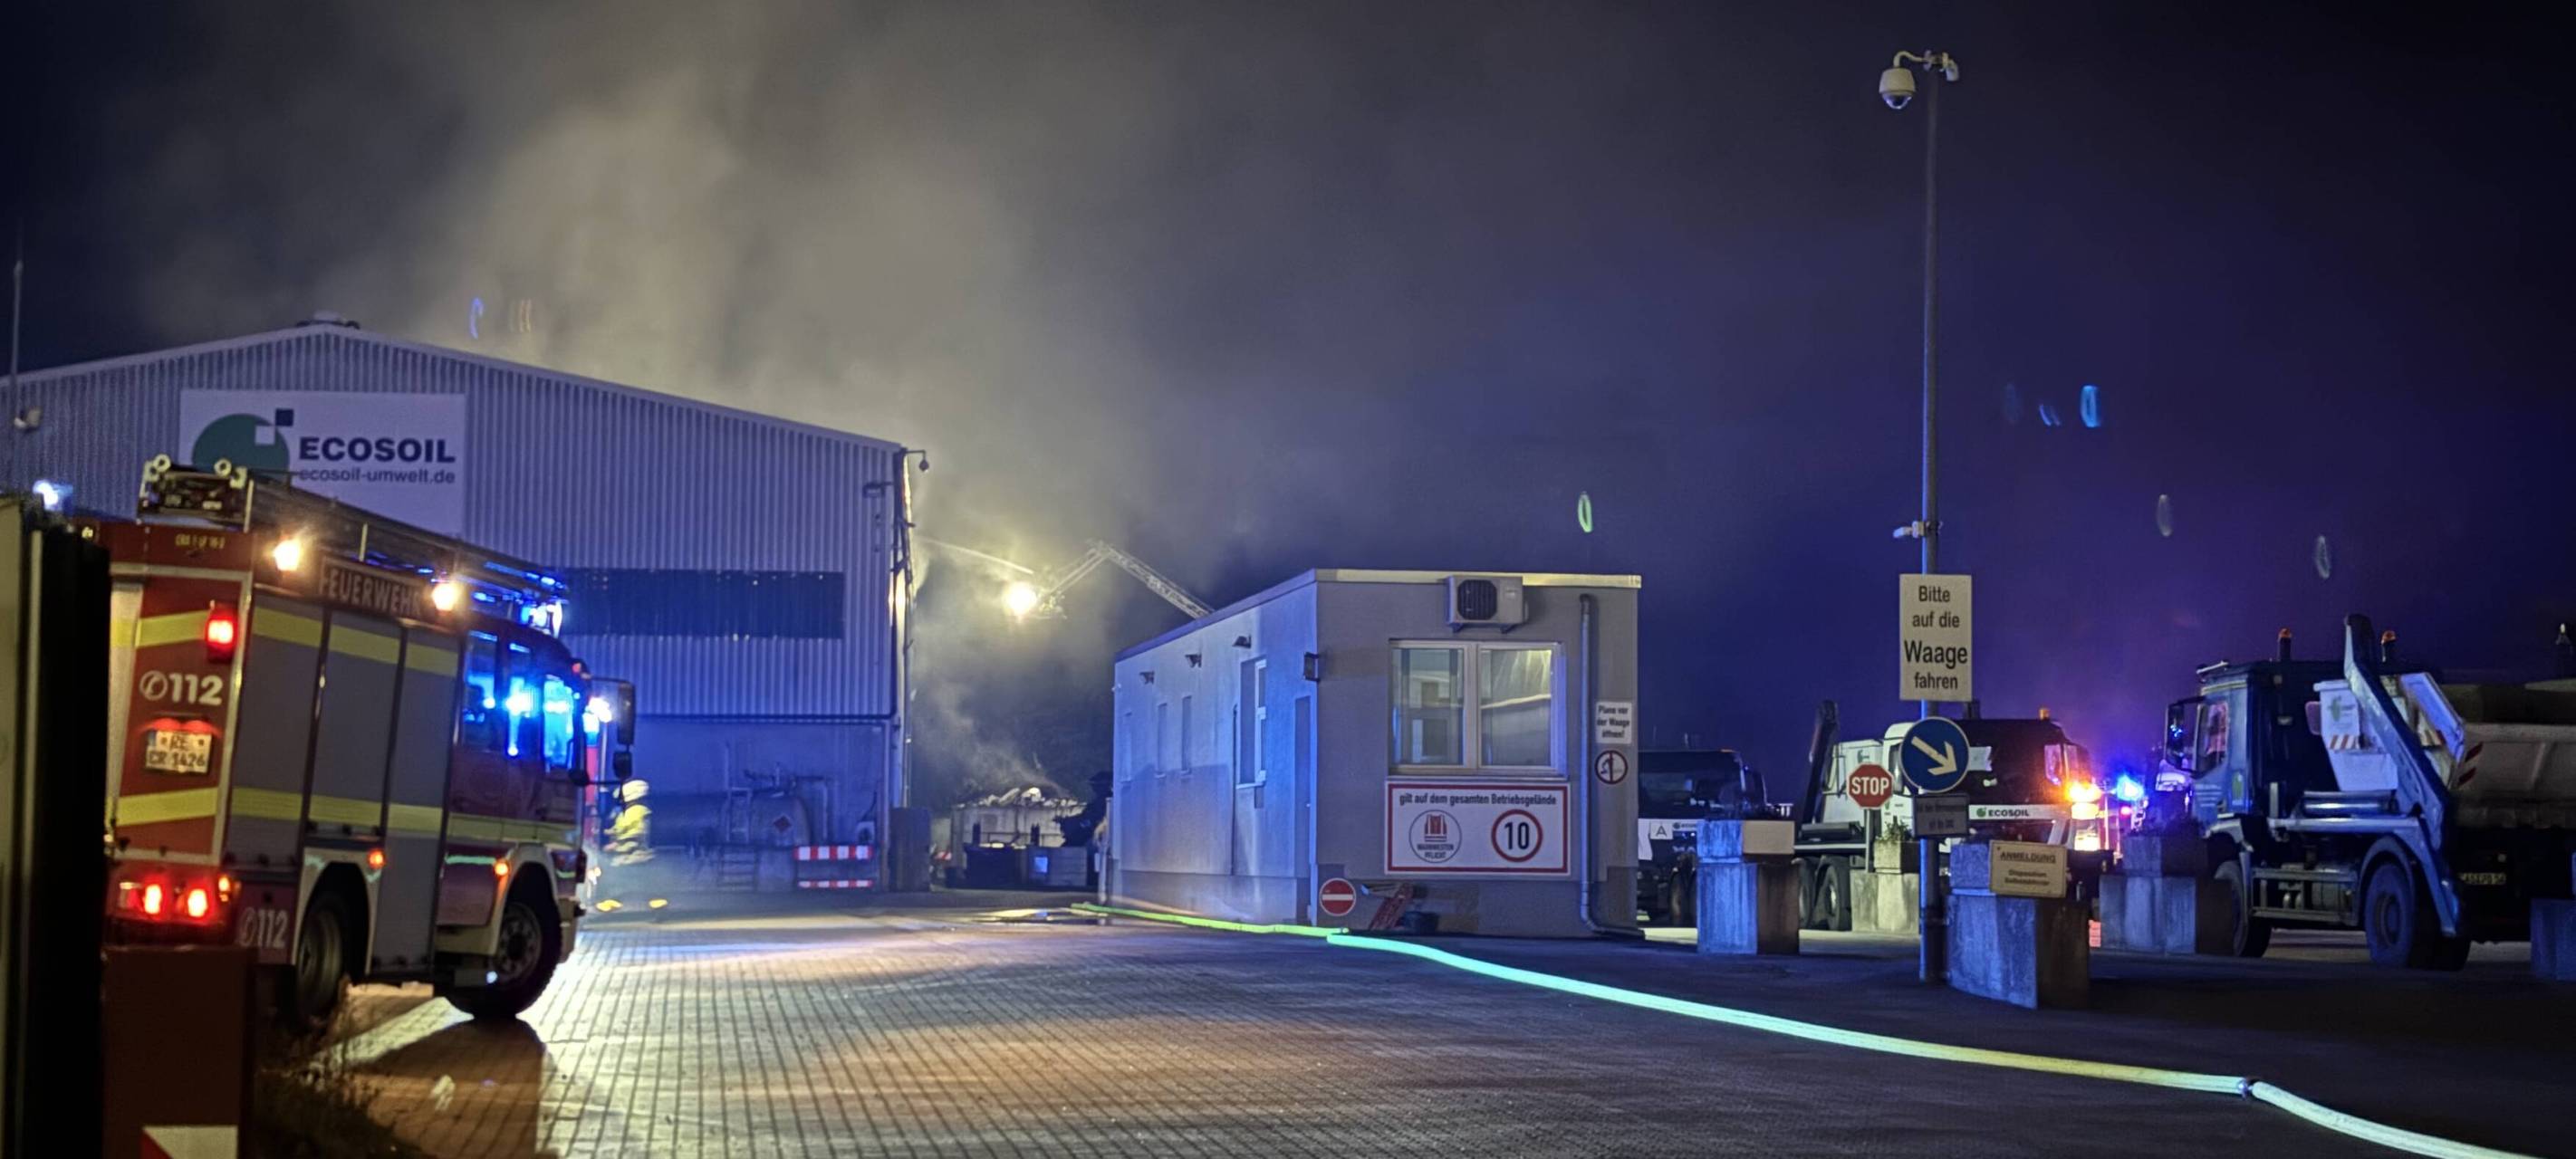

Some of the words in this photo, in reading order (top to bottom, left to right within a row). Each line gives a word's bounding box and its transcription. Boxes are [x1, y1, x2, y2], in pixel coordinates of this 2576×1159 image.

[299, 436, 456, 463] ECOSOIL
[299, 465, 456, 484] ecosoil-umwelt.de
[318, 563, 421, 616] FEUERWEHR
[1918, 585, 1951, 603] Bitte
[1912, 610, 1935, 627] auf
[1938, 610, 1960, 628] die
[1904, 639, 1967, 669] Waage
[168, 673, 223, 705] 112
[1914, 671, 1958, 689] fahren
[1597, 718, 1608, 726] der
[1609, 718, 1630, 729] Waage
[1851, 776, 1889, 796] STOP
[1399, 793, 1413, 806] gilt
[1414, 792, 1428, 804] auf
[1429, 793, 1447, 804] dem
[1449, 794, 1489, 807] gesamten
[1491, 793, 1556, 807] Betriebsgelände
[1988, 809, 2029, 818] ECOSOIL
[1504, 821, 1530, 850] 10
[1656, 825, 1668, 837] A
[2000, 851, 2056, 864] ANMELDUNG
[257, 909, 288, 949] 112
